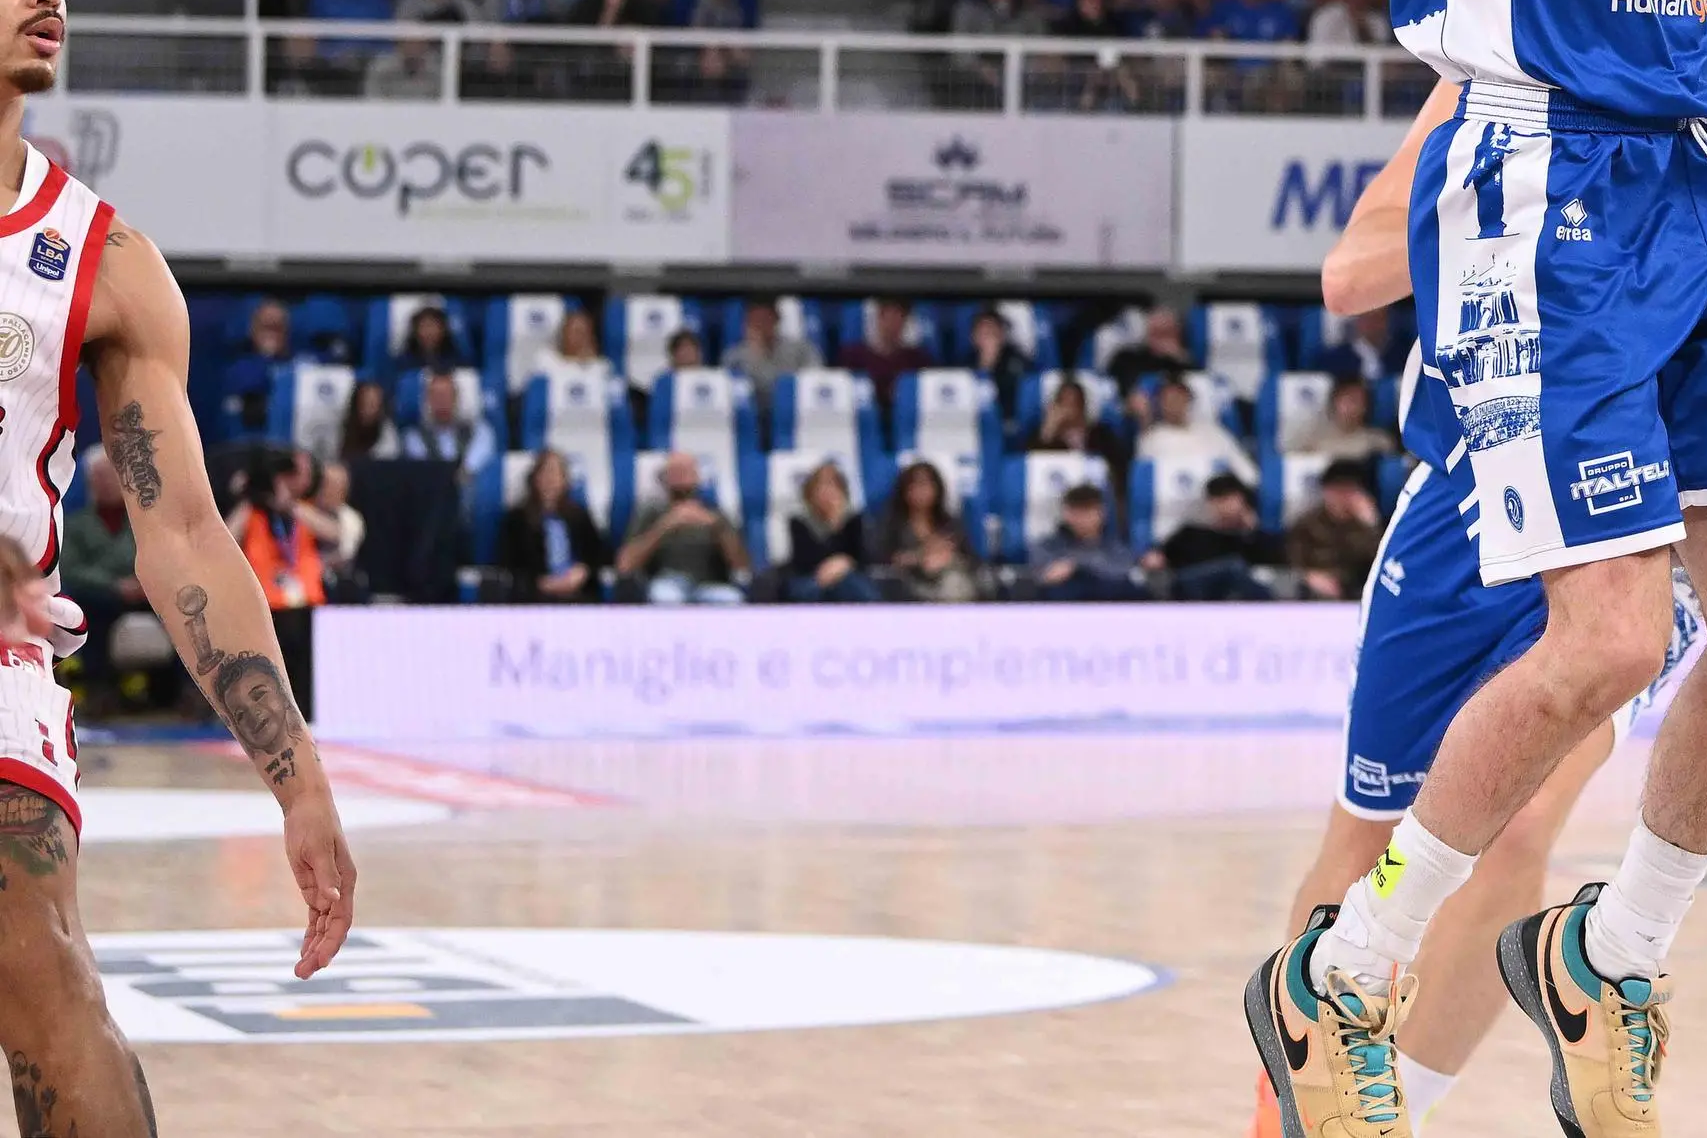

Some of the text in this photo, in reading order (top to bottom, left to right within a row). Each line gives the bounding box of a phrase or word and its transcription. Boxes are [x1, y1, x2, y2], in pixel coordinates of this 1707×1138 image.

[1556, 223, 1593, 242] errea
[36, 243, 65, 264] LBA
[35, 262, 61, 277] Unipol
[1587, 461, 1629, 477] GRUPPO
[756, 646, 792, 689] e
